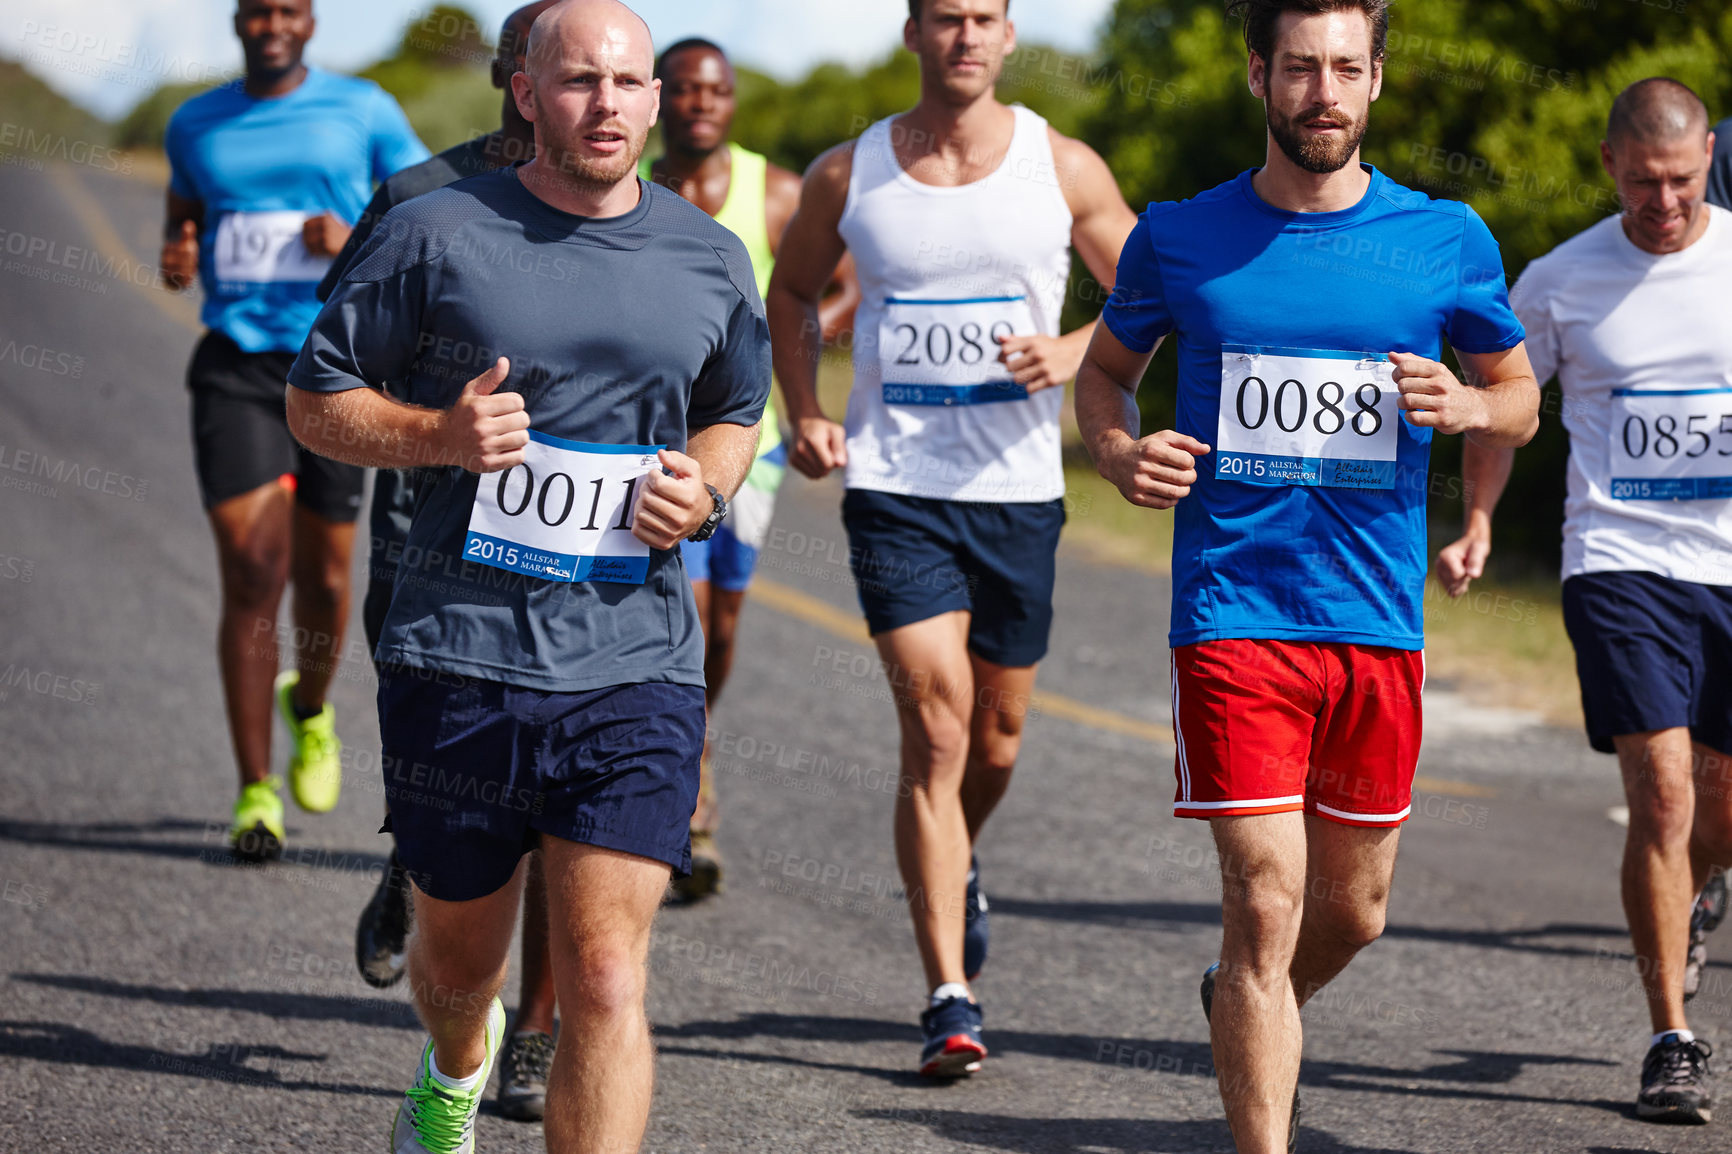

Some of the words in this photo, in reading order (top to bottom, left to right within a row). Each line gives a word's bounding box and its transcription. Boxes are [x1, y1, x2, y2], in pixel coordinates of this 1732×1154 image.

[1236, 376, 1382, 437] 0088
[1623, 414, 1732, 459] 0855
[1219, 457, 1265, 476] 2015
[1269, 461, 1304, 470] ALLSTAR
[1335, 473, 1382, 486] Enterprises
[497, 462, 637, 531] 0011
[1614, 481, 1651, 497] 2015
[467, 538, 519, 565] 2015
[523, 552, 560, 567] ALLSTAR
